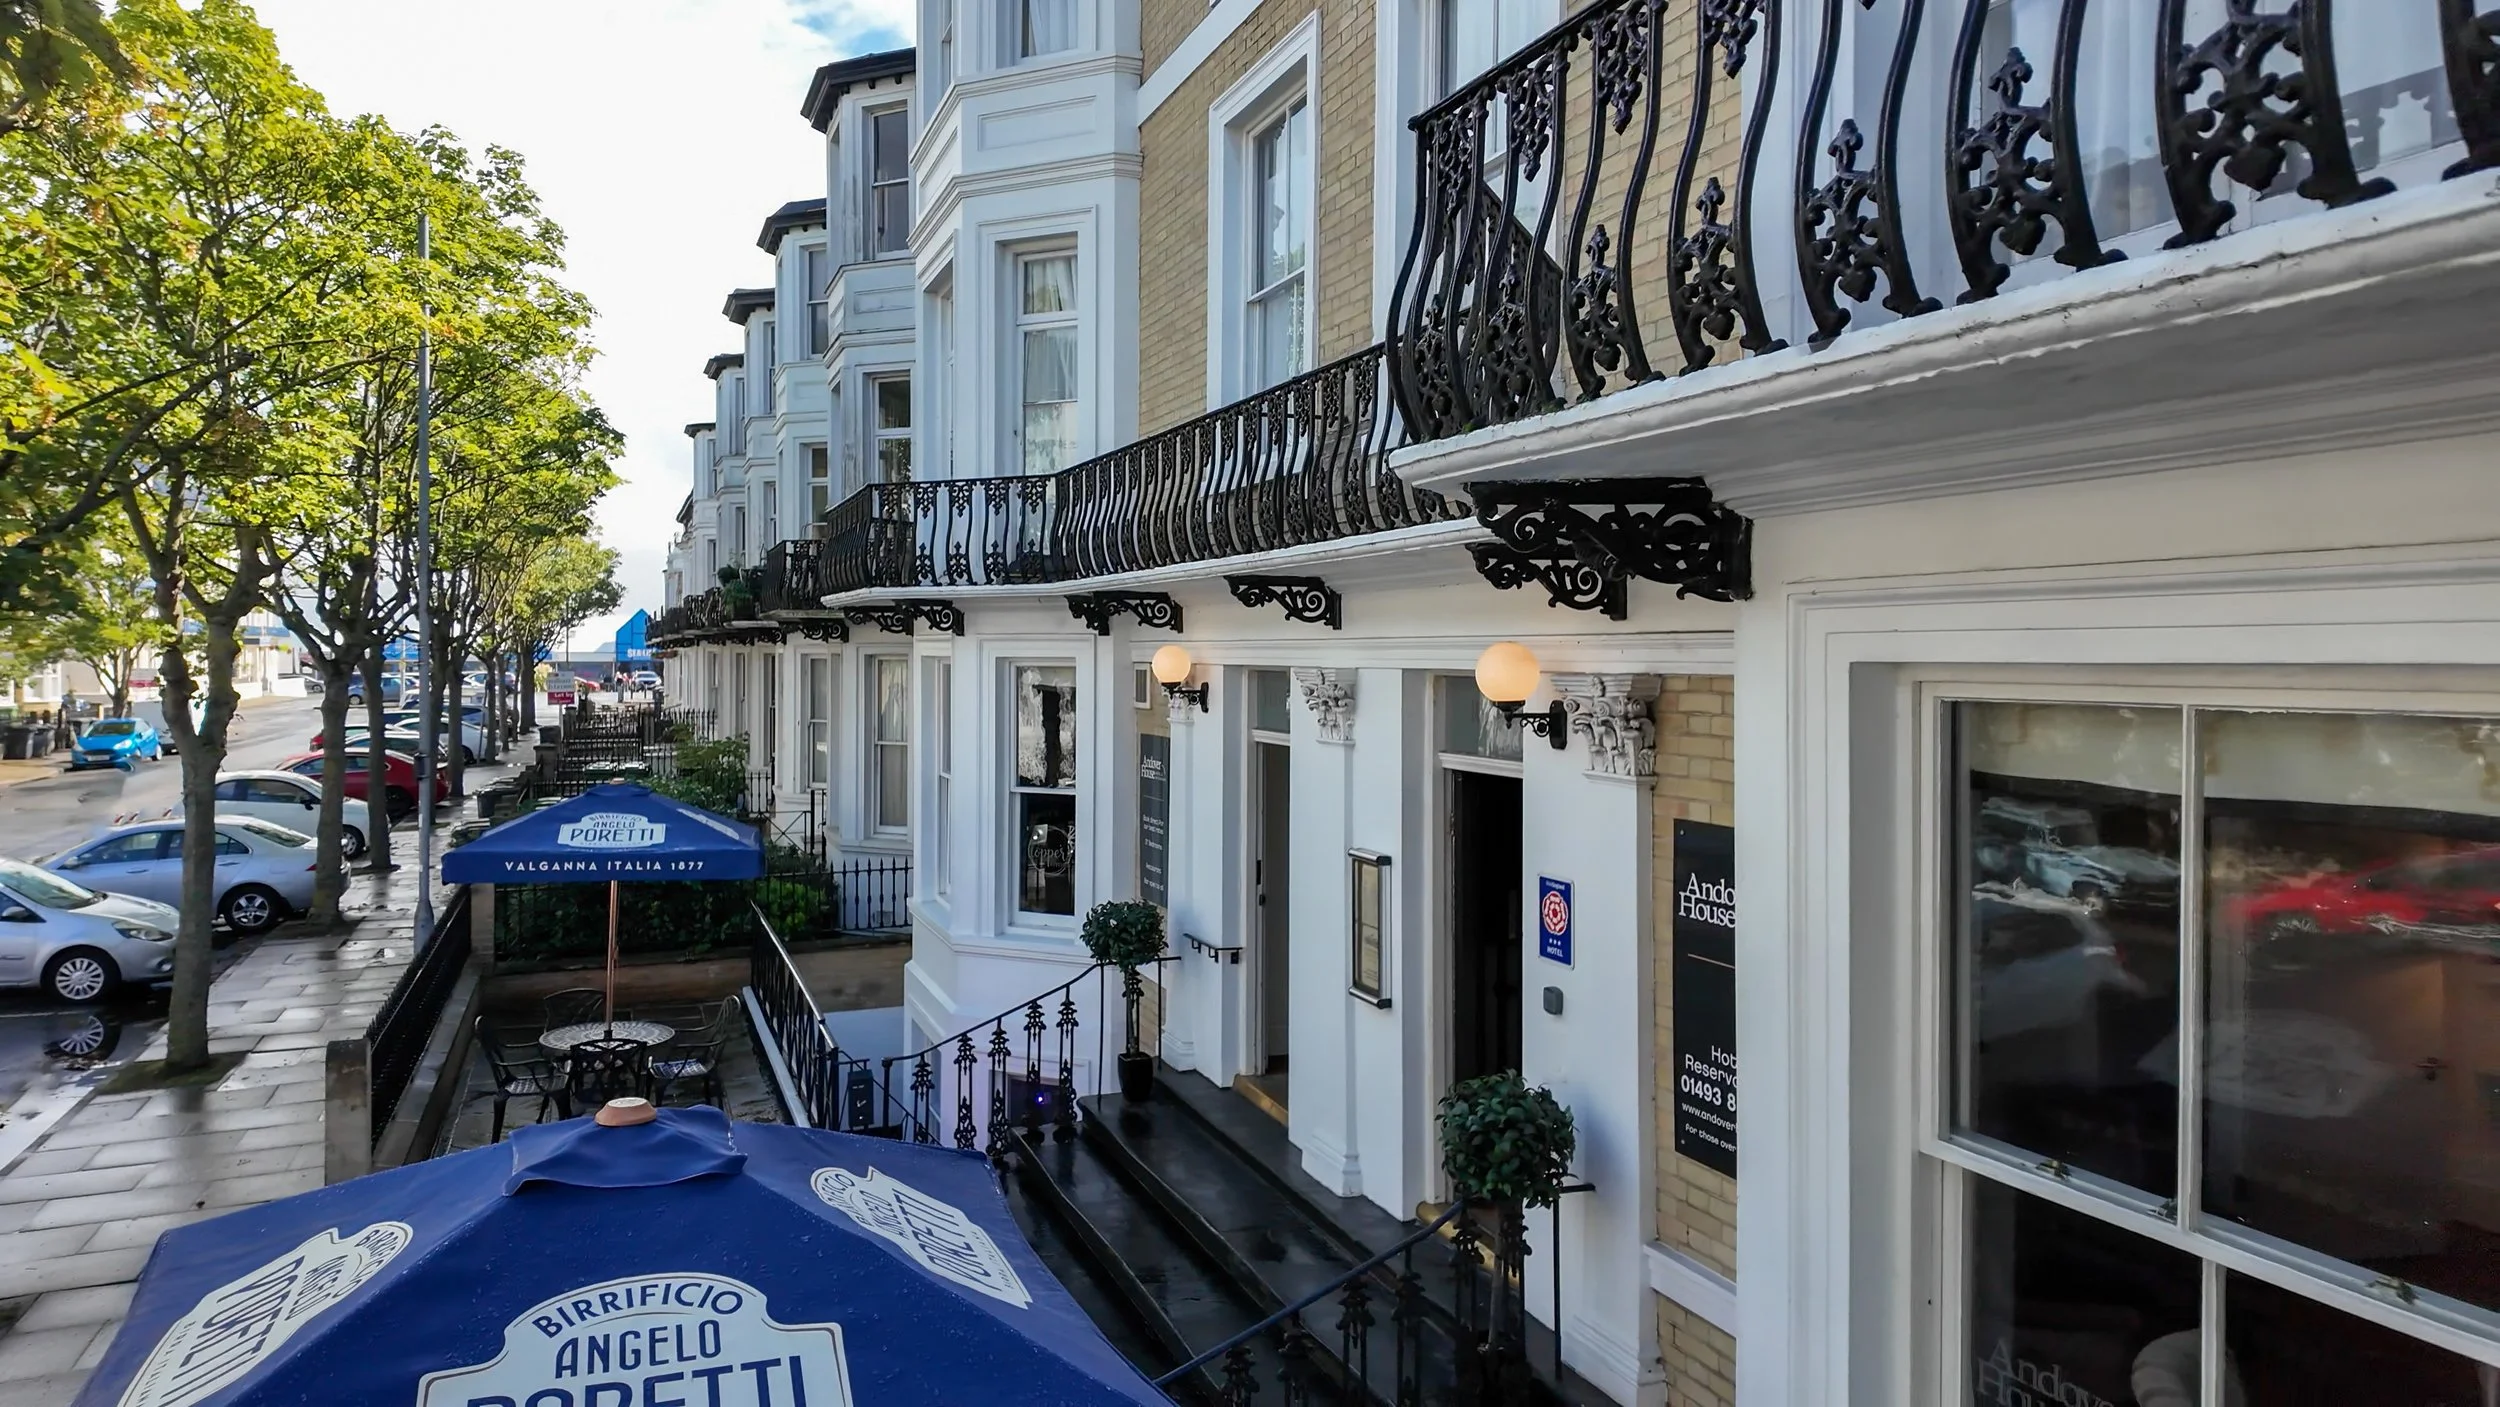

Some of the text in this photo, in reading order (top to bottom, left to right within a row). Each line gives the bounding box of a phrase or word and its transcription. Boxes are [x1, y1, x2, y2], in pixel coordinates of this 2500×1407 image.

[570, 828, 654, 842] PORETTI
[505, 861, 704, 872] VALGANNA ITALIA 1877
[1678, 891, 1736, 928] House
[1681, 1074, 1722, 1106] 01493
[1681, 1102, 1737, 1132] www.andover
[892, 1188, 1003, 1292] PORETTI
[532, 1282, 744, 1338] BIRRIFICIO
[157, 1255, 305, 1407] PORETTI
[555, 1319, 722, 1379] ANGELO
